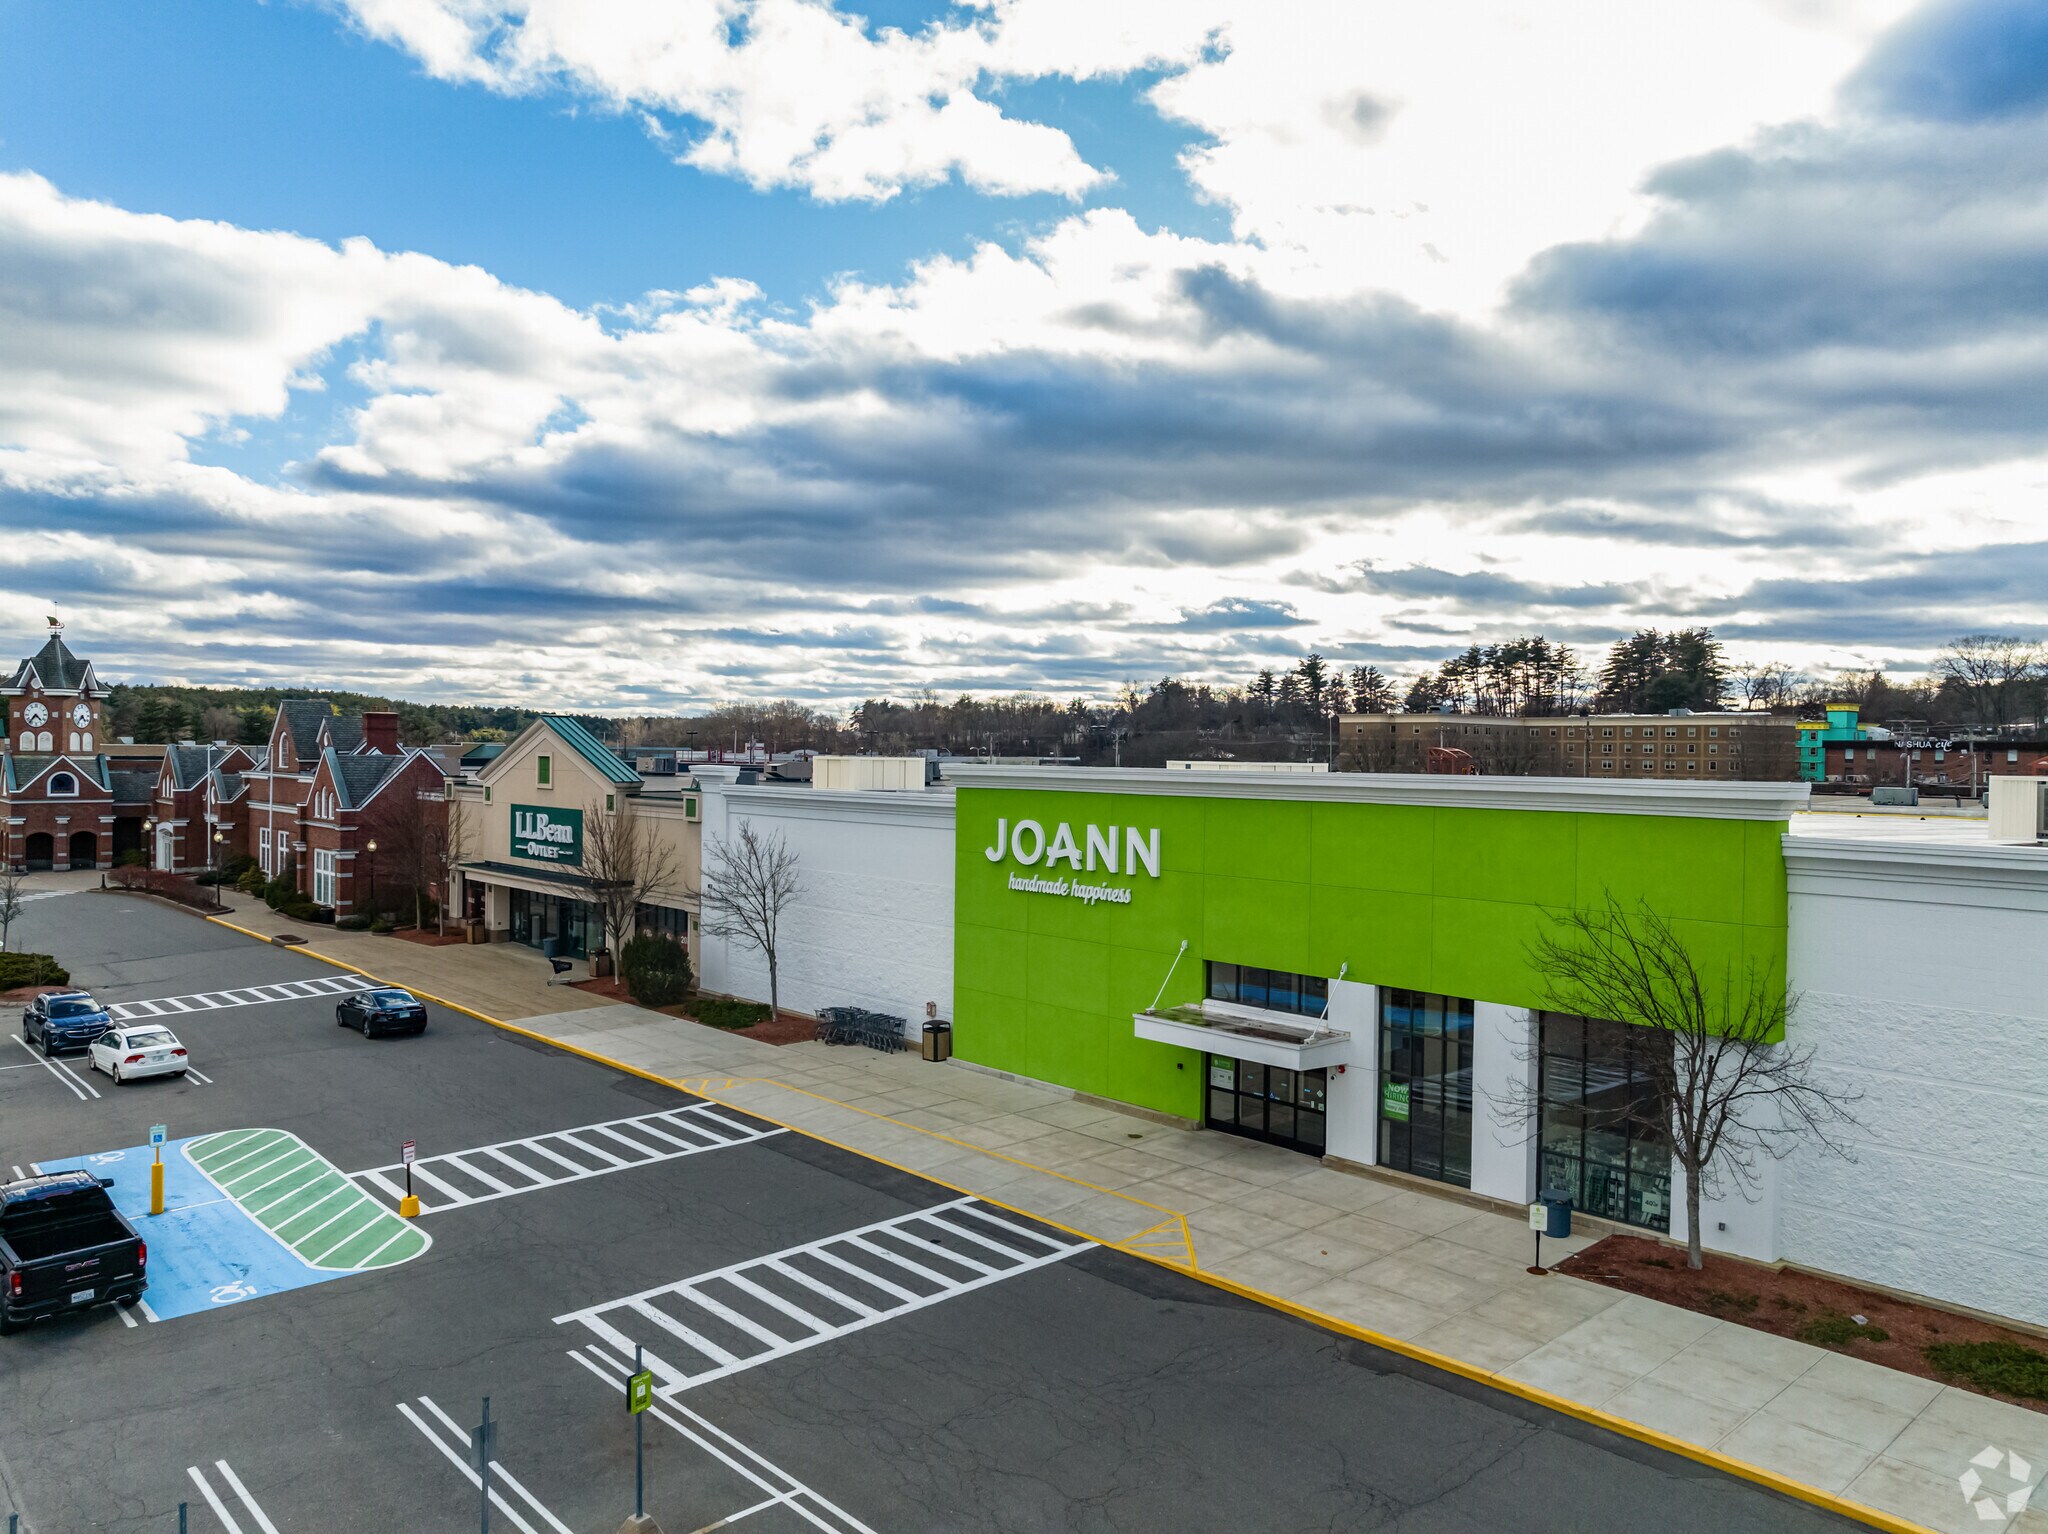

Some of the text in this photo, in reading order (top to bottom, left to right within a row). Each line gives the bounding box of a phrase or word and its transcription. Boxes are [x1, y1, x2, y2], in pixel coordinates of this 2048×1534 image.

[1935, 740, 1953, 752] eye
[527, 841, 560, 858] OUTLET
[984, 818, 1161, 878] JOANN
[1008, 871, 1132, 905] handmade happiness
[1388, 1083, 1409, 1095] NOW
